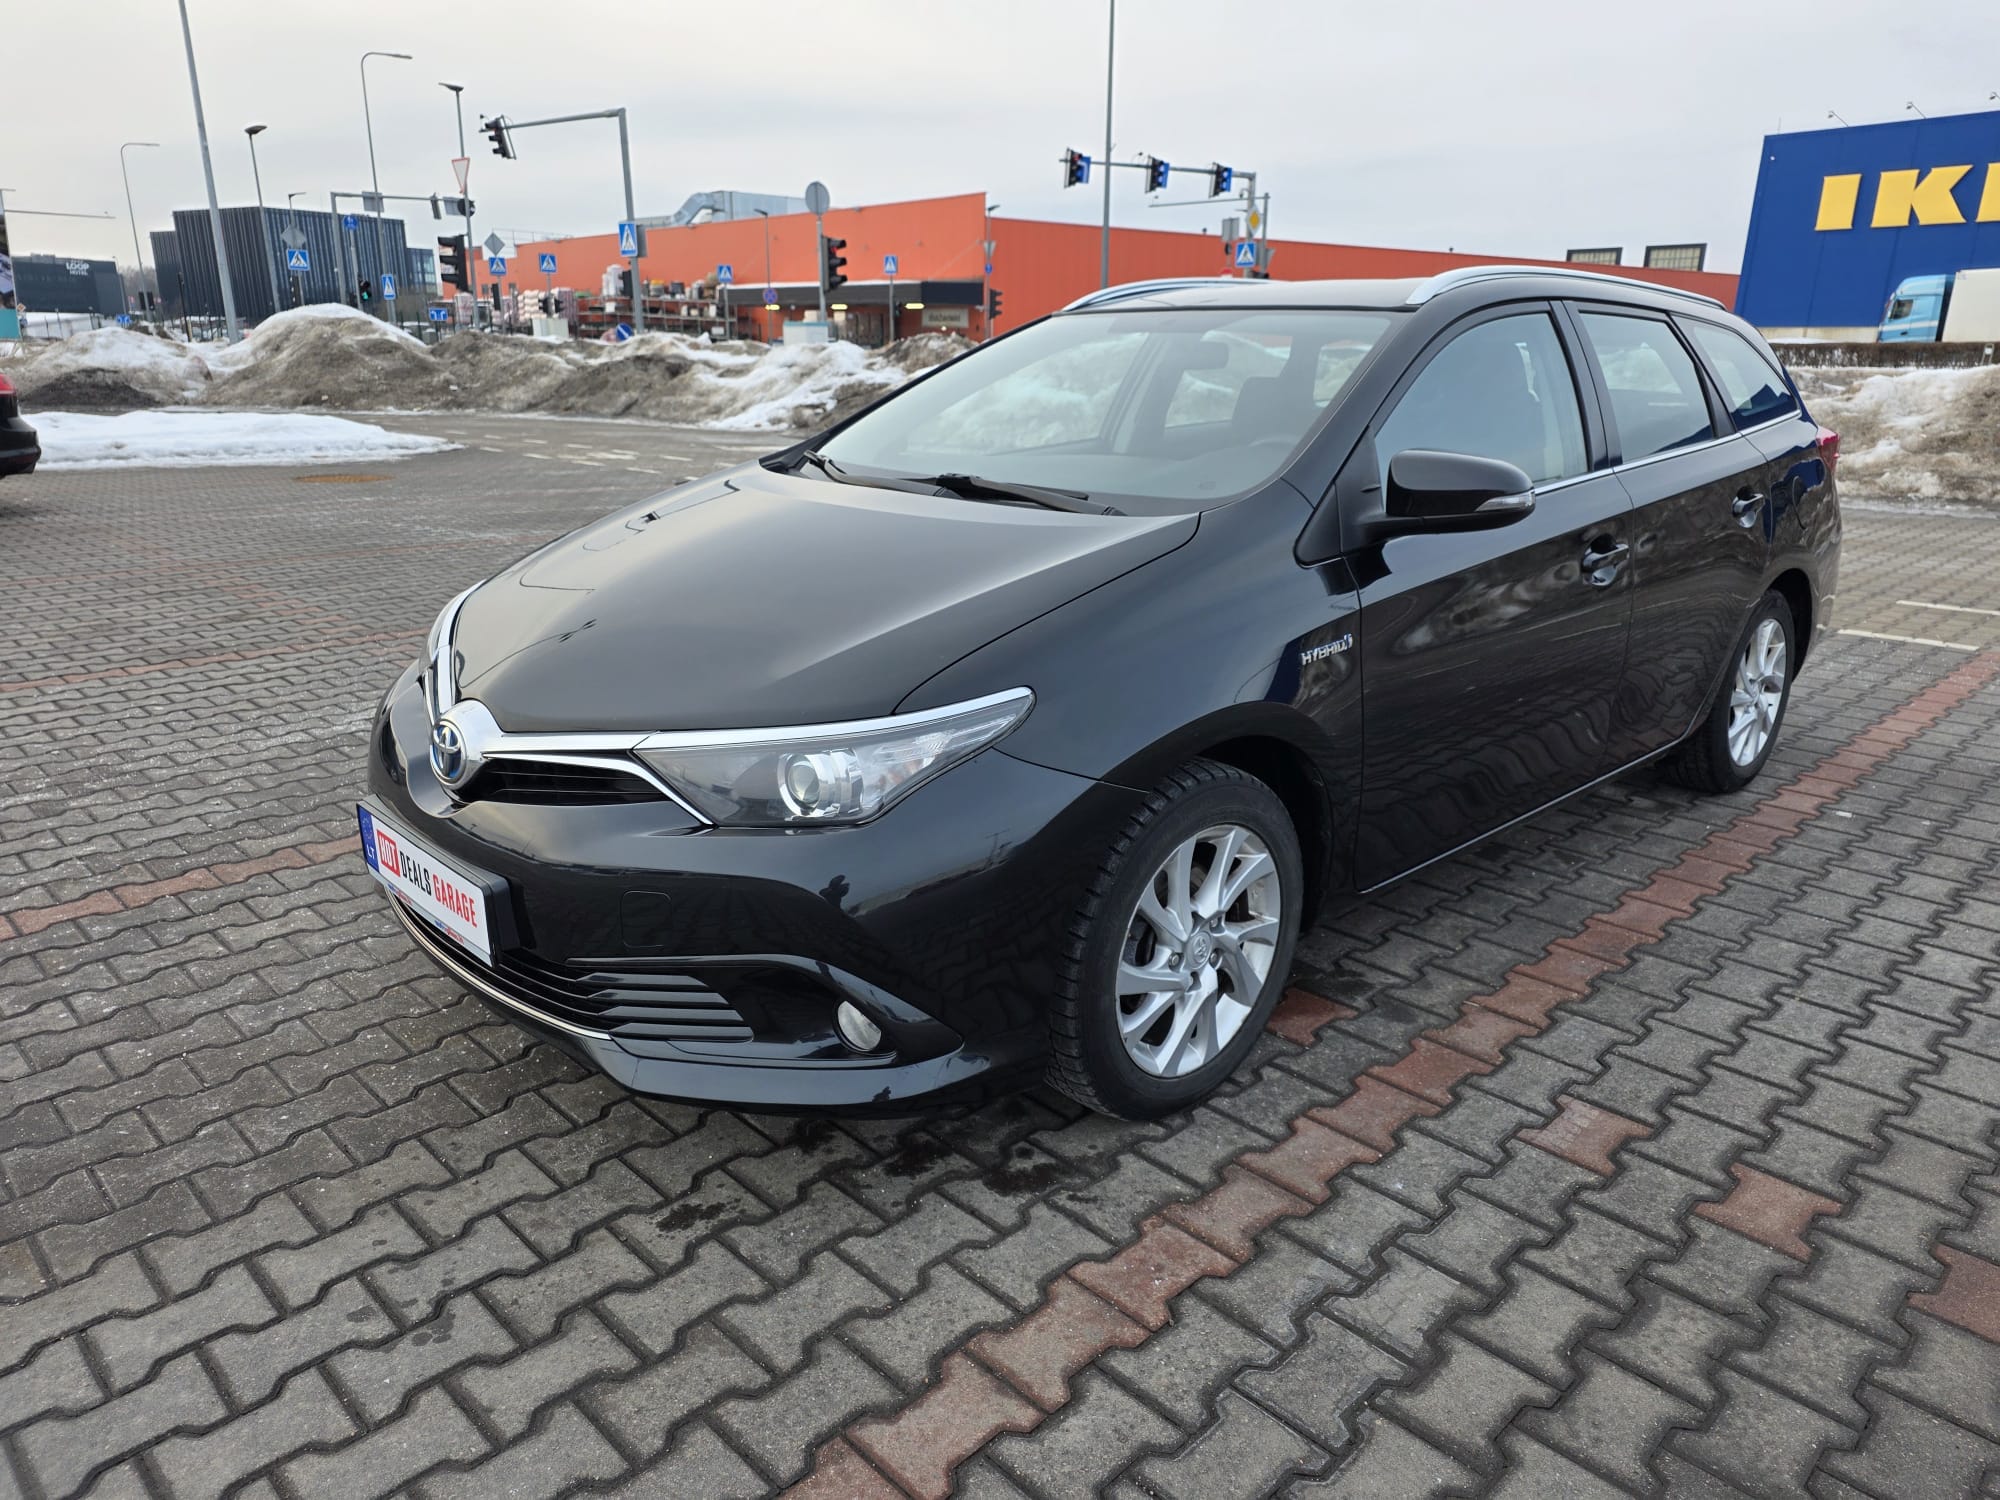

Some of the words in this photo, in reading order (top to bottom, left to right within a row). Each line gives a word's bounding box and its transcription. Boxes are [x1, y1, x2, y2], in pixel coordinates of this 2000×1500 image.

[66, 262, 90, 270] LOOP
[1301, 637, 1349, 665] HYBRID
[366, 844, 375, 860] LT
[379, 836, 396, 871] HOT
[400, 851, 432, 896] DEALS
[433, 874, 478, 927] GARAGE
